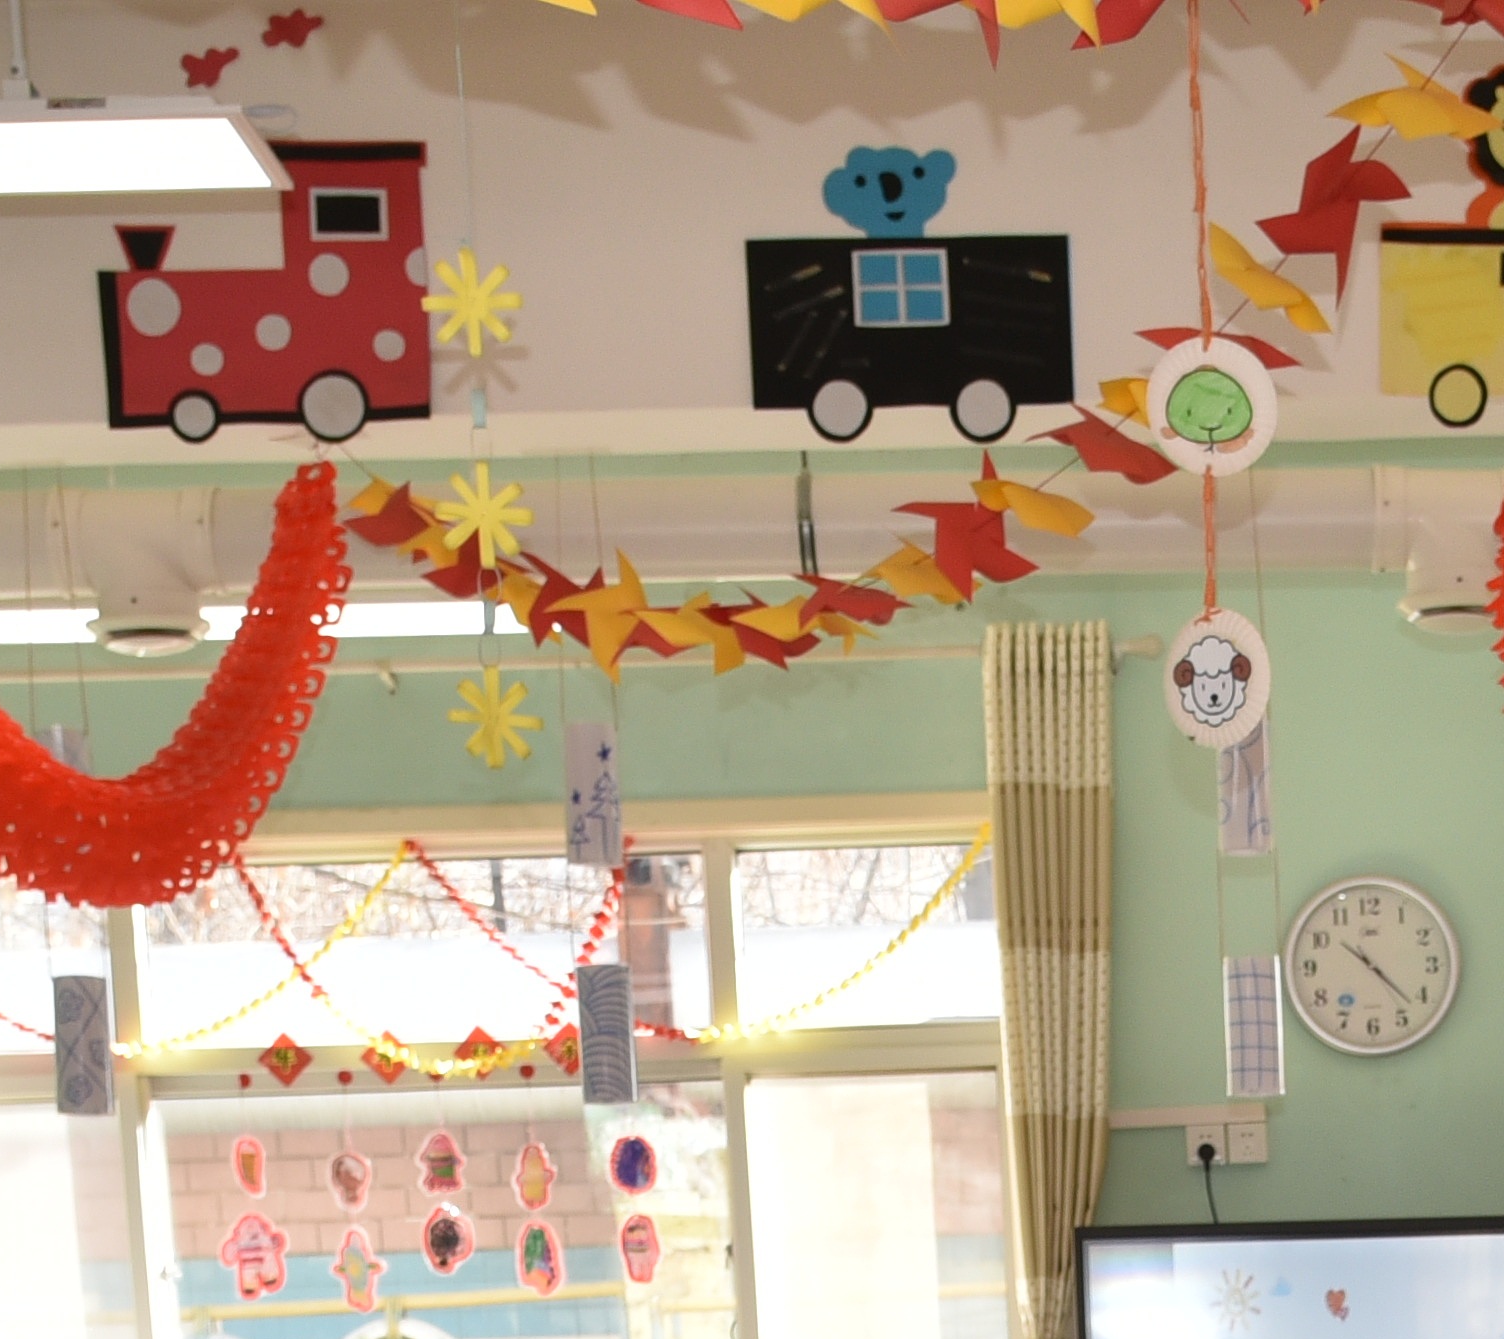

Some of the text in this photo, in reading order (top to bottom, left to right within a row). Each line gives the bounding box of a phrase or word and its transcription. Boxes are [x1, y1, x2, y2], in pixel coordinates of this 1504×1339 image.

[1358, 897, 1381, 916] 12
[1333, 908, 1349, 926] 11
[1312, 932, 1330, 949] 10
[1416, 929, 1430, 947] 2
[1303, 959, 1317, 977] 9
[1425, 957, 1439, 974] 3
[1314, 989, 1328, 1007] 8
[1415, 986, 1428, 1004] 4
[1337, 1011, 1350, 1029] 7
[1366, 1018, 1380, 1035] 6
[1395, 1009, 1409, 1027] 5
